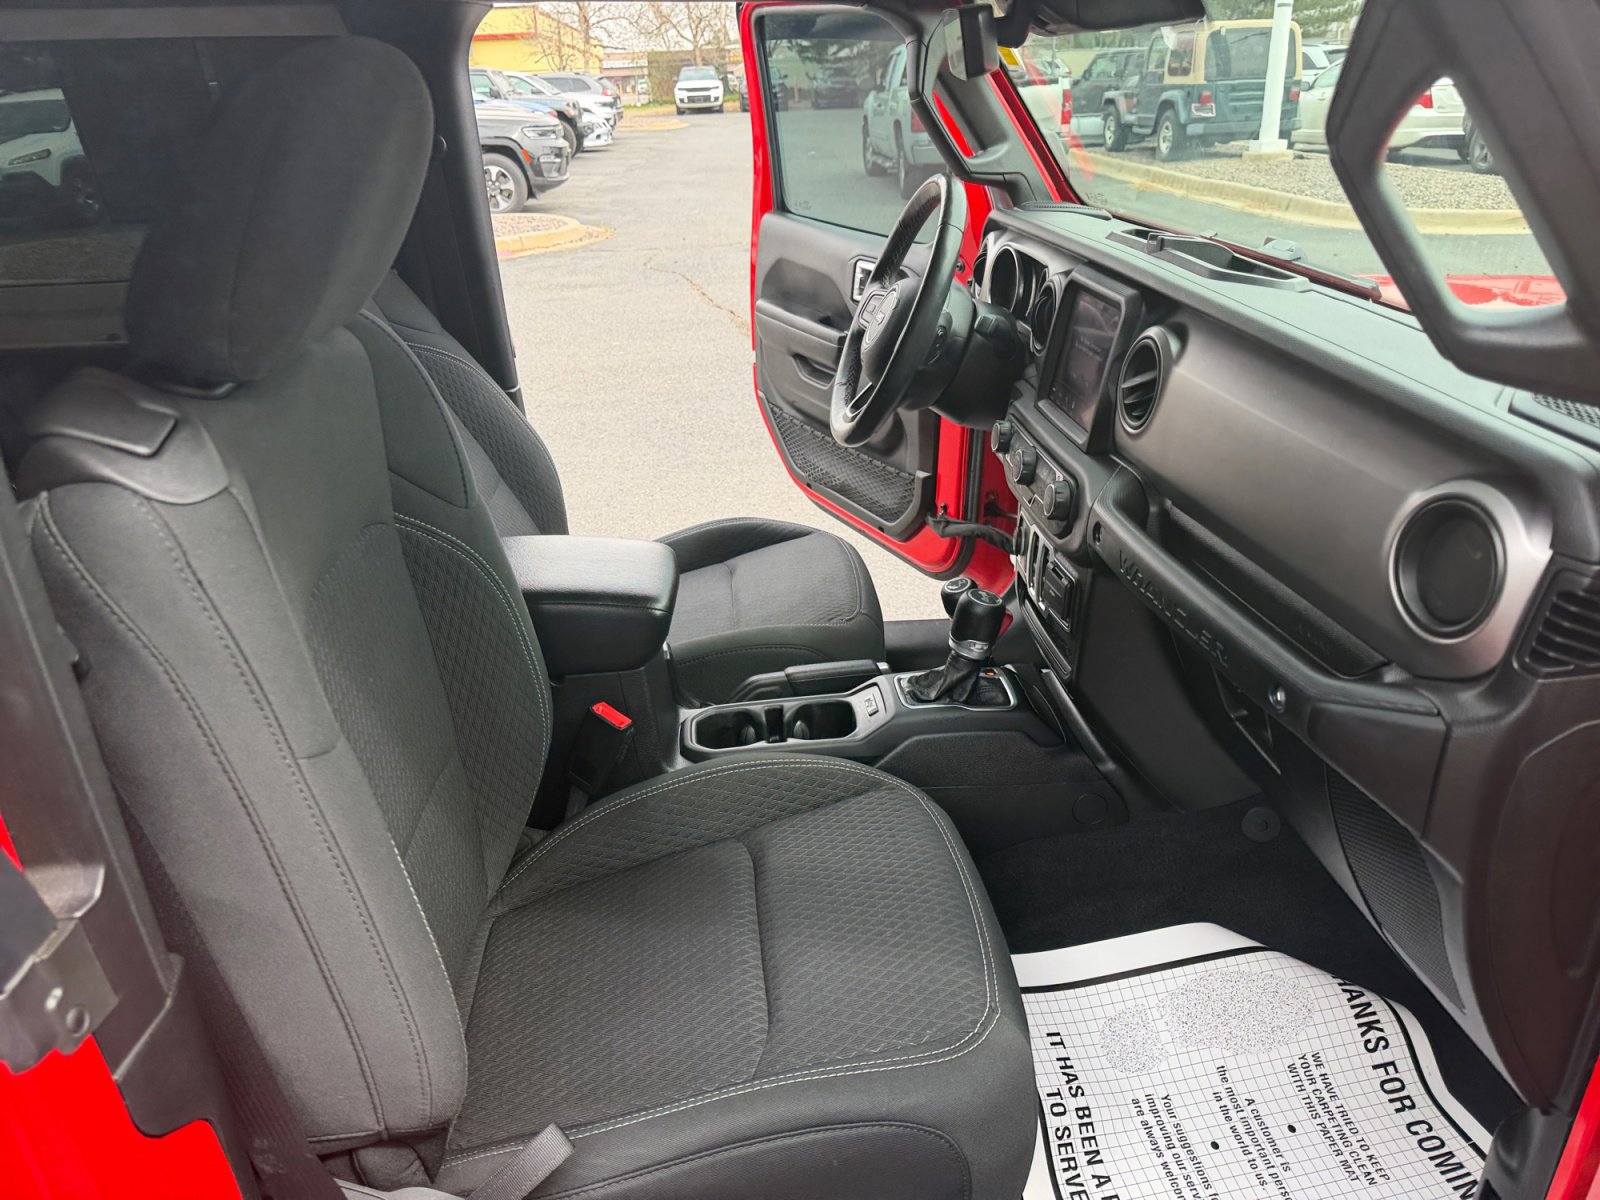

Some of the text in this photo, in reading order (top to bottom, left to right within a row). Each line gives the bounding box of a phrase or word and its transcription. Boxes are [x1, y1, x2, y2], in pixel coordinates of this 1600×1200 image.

[1046, 1032, 1066, 1049] IT
[1056, 1057, 1085, 1098] HAS
[1074, 1105, 1104, 1166] BEEN
[1091, 1174, 1112, 1189] A
[1131, 1098, 1145, 1117] are
[1140, 1119, 1165, 1159] always
[1216, 1065, 1229, 1083] the
[1225, 1087, 1245, 1113] most
[1240, 1116, 1275, 1169] important
[1245, 1098, 1291, 1172] A customer is
[1287, 1063, 1360, 1182] WITH THIS PAPER MAT
[1298, 1054, 1378, 1186] YOUR CARPETING CLEAN
[1311, 1052, 1391, 1181] WE HAVE TRIED TO KEEP
[1372, 1060, 1417, 1114] FOR
[1046, 1088, 1090, 1200] TO SERVE
[1145, 1093, 1204, 1200] improving our serv
[1161, 1094, 1177, 1120] Your
[1173, 1122, 1212, 1190] suggestions
[1212, 1091, 1268, 1191] in the world to us.
